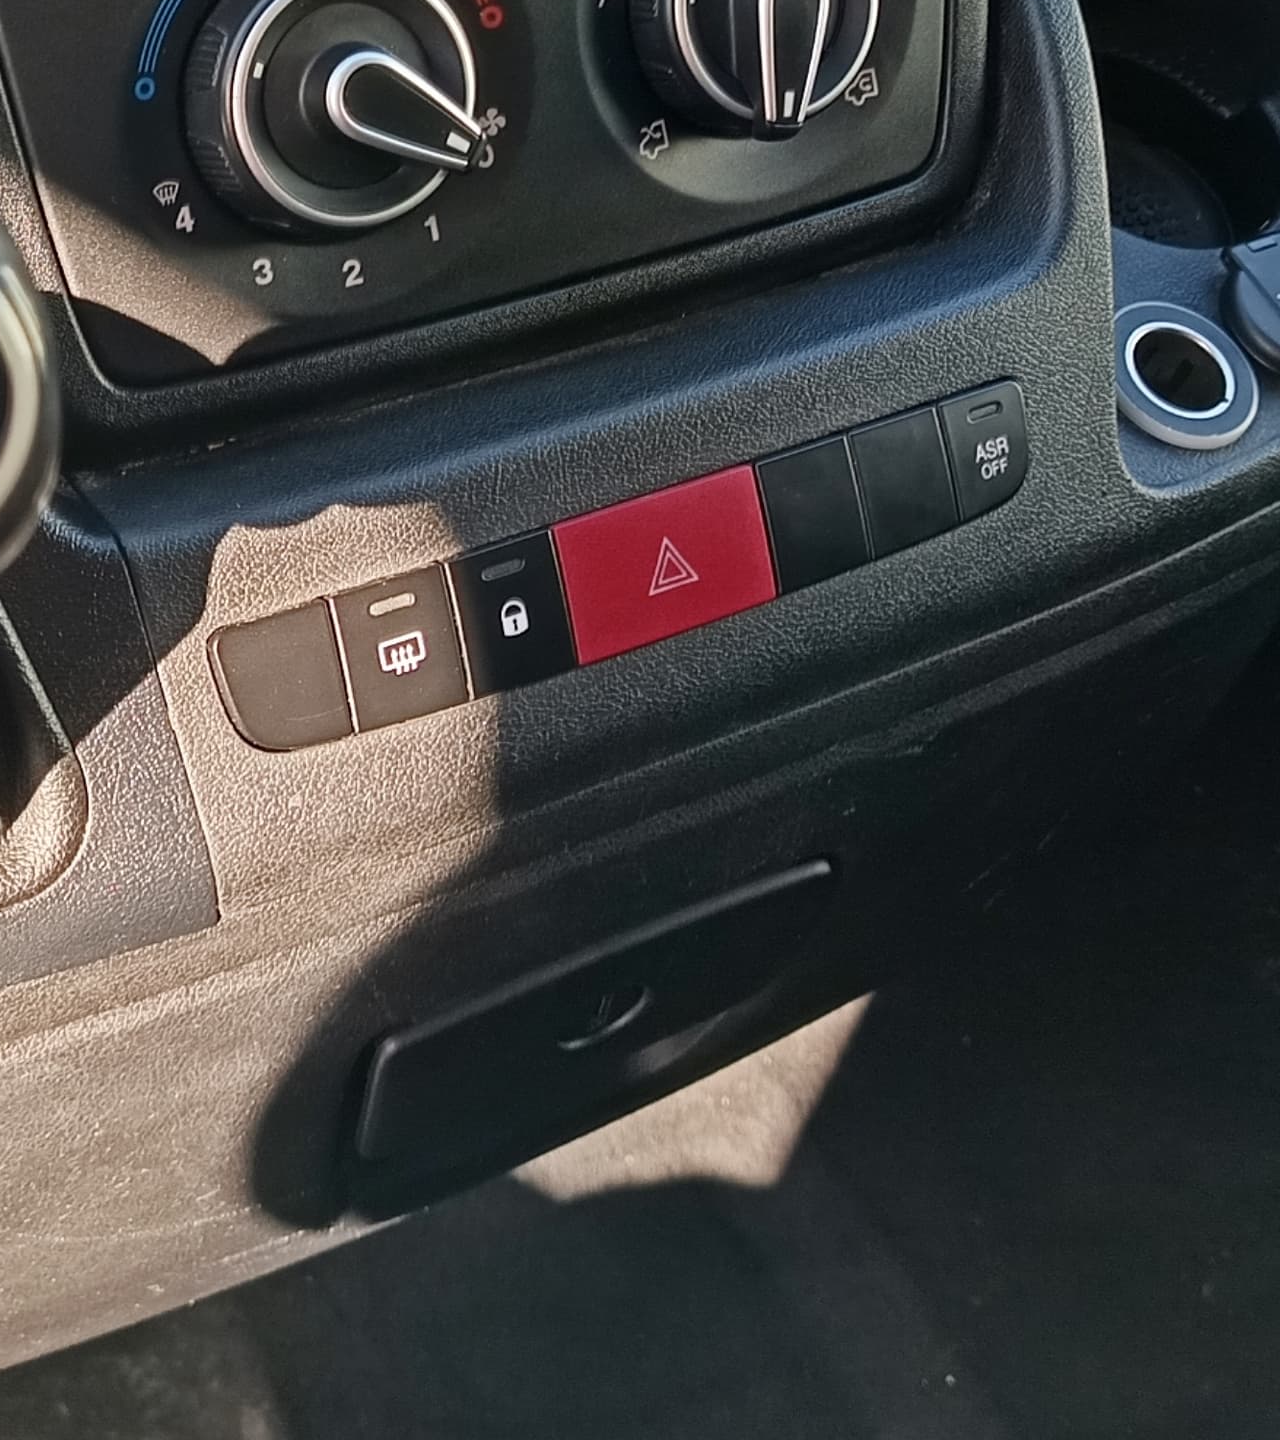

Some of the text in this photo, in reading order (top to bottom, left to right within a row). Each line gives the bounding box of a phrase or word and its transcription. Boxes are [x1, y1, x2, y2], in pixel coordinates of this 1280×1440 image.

[176, 206, 194, 232] 4
[424, 216, 439, 241] 1
[253, 259, 273, 285] 3
[343, 259, 363, 287] 2
[976, 437, 1008, 463] ASR
[981, 457, 1007, 479] OFF
